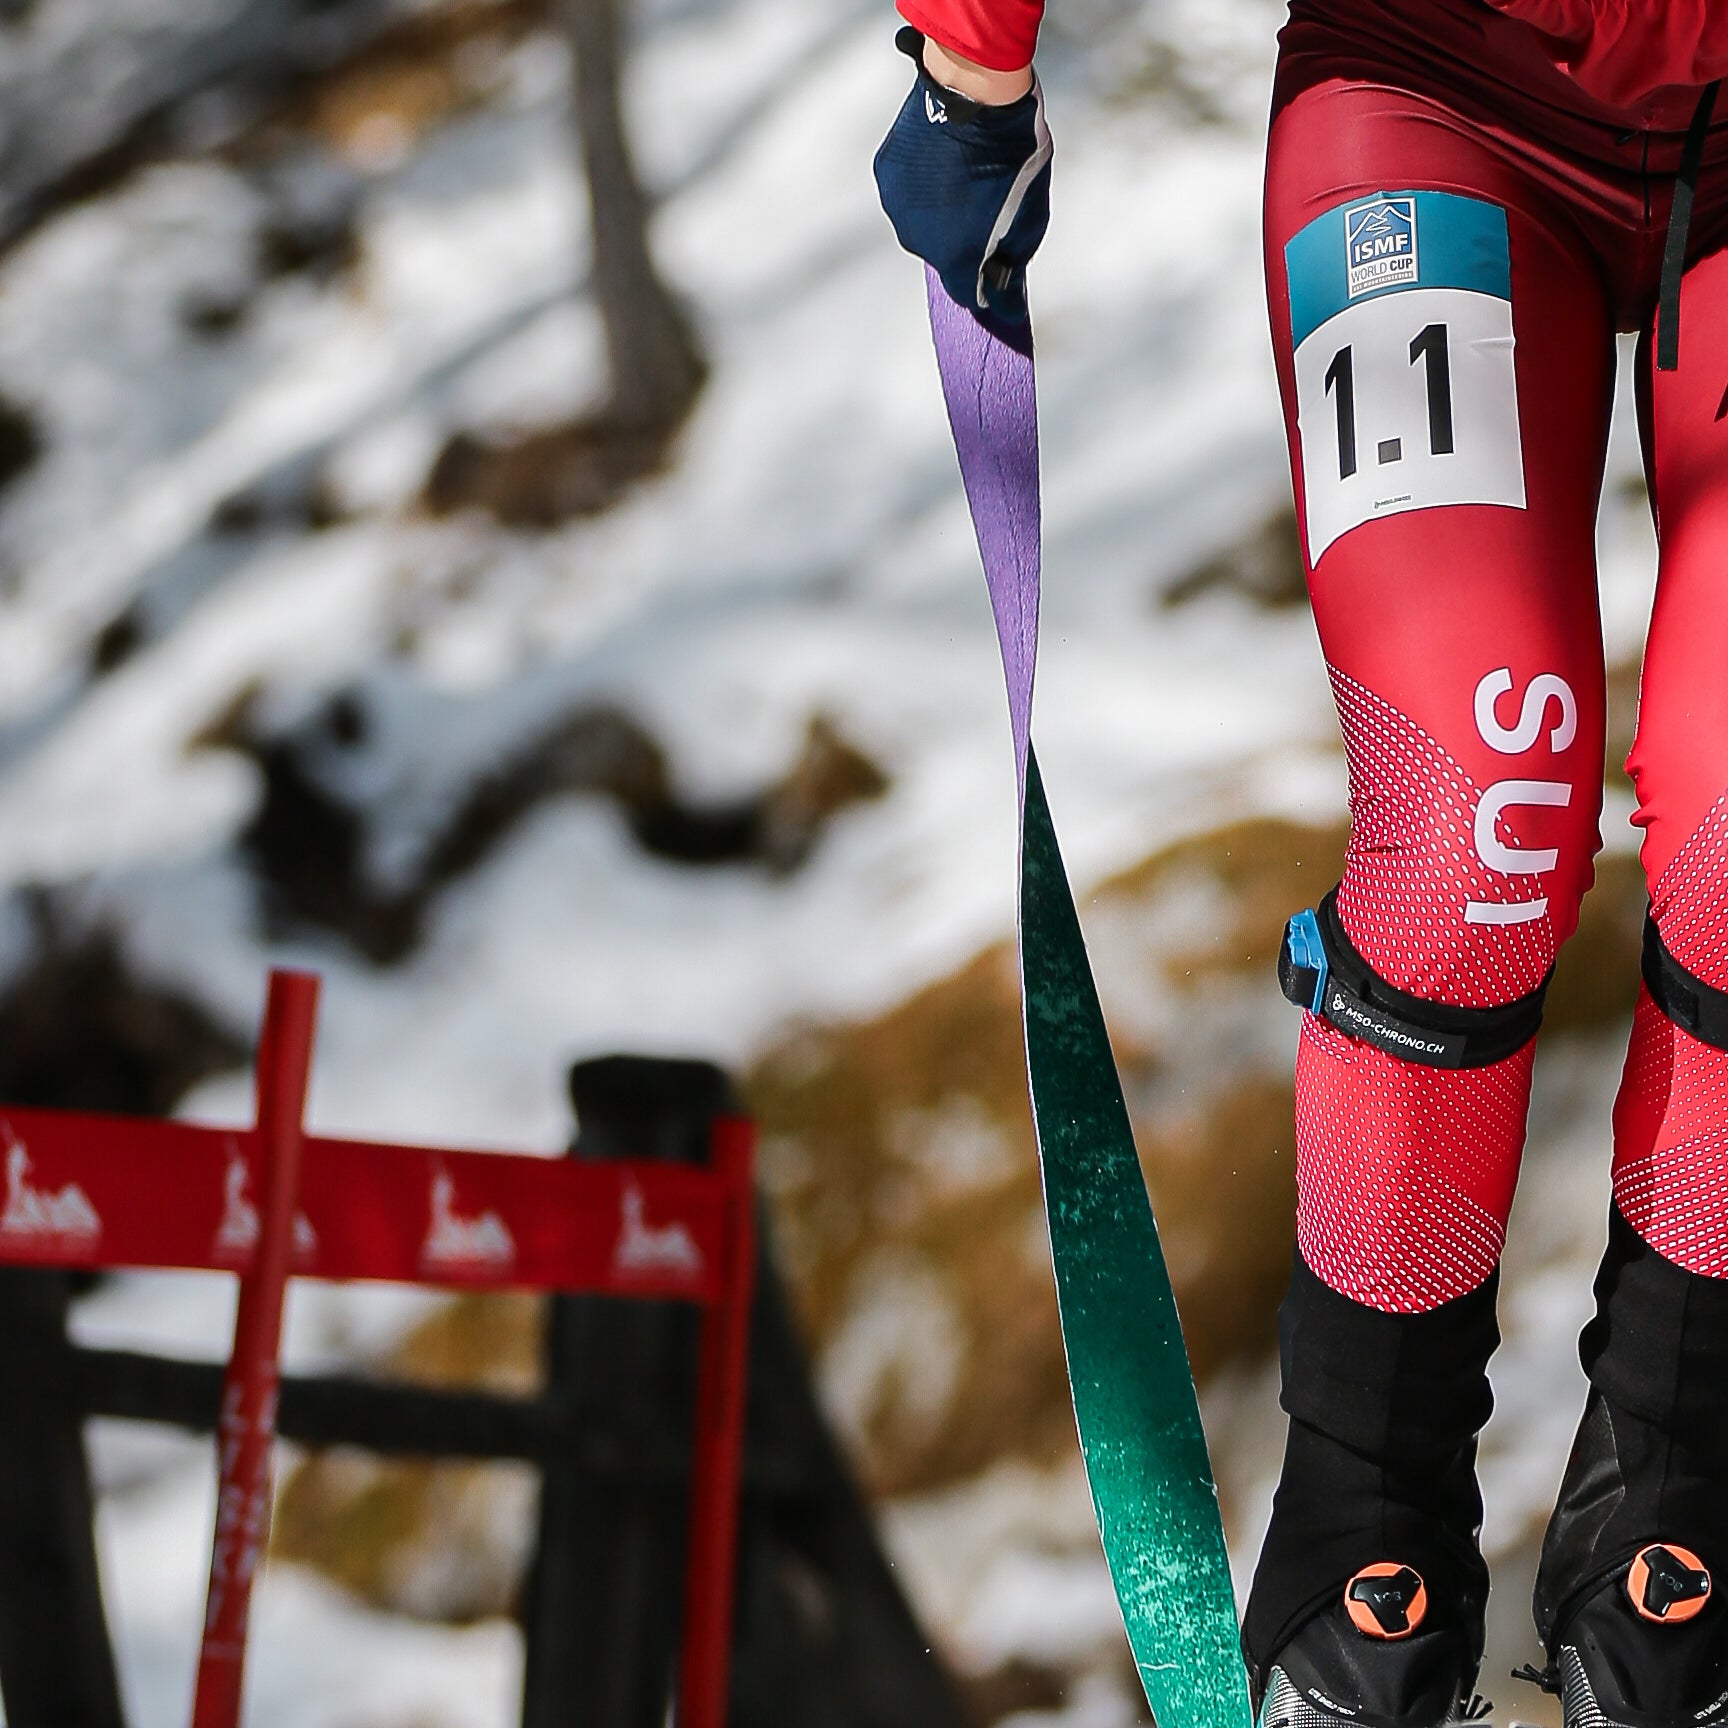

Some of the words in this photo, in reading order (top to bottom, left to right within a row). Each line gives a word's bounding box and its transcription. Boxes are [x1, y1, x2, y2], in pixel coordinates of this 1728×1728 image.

[1350, 262, 1388, 284] WORLD
[1389, 257, 1414, 272] CUP
[1354, 233, 1409, 264] ISMF
[1324, 323, 1455, 480] 1.1
[1463, 667, 1578, 925] SUI
[1345, 1007, 1445, 1055] MSO-CHRONO.CH
